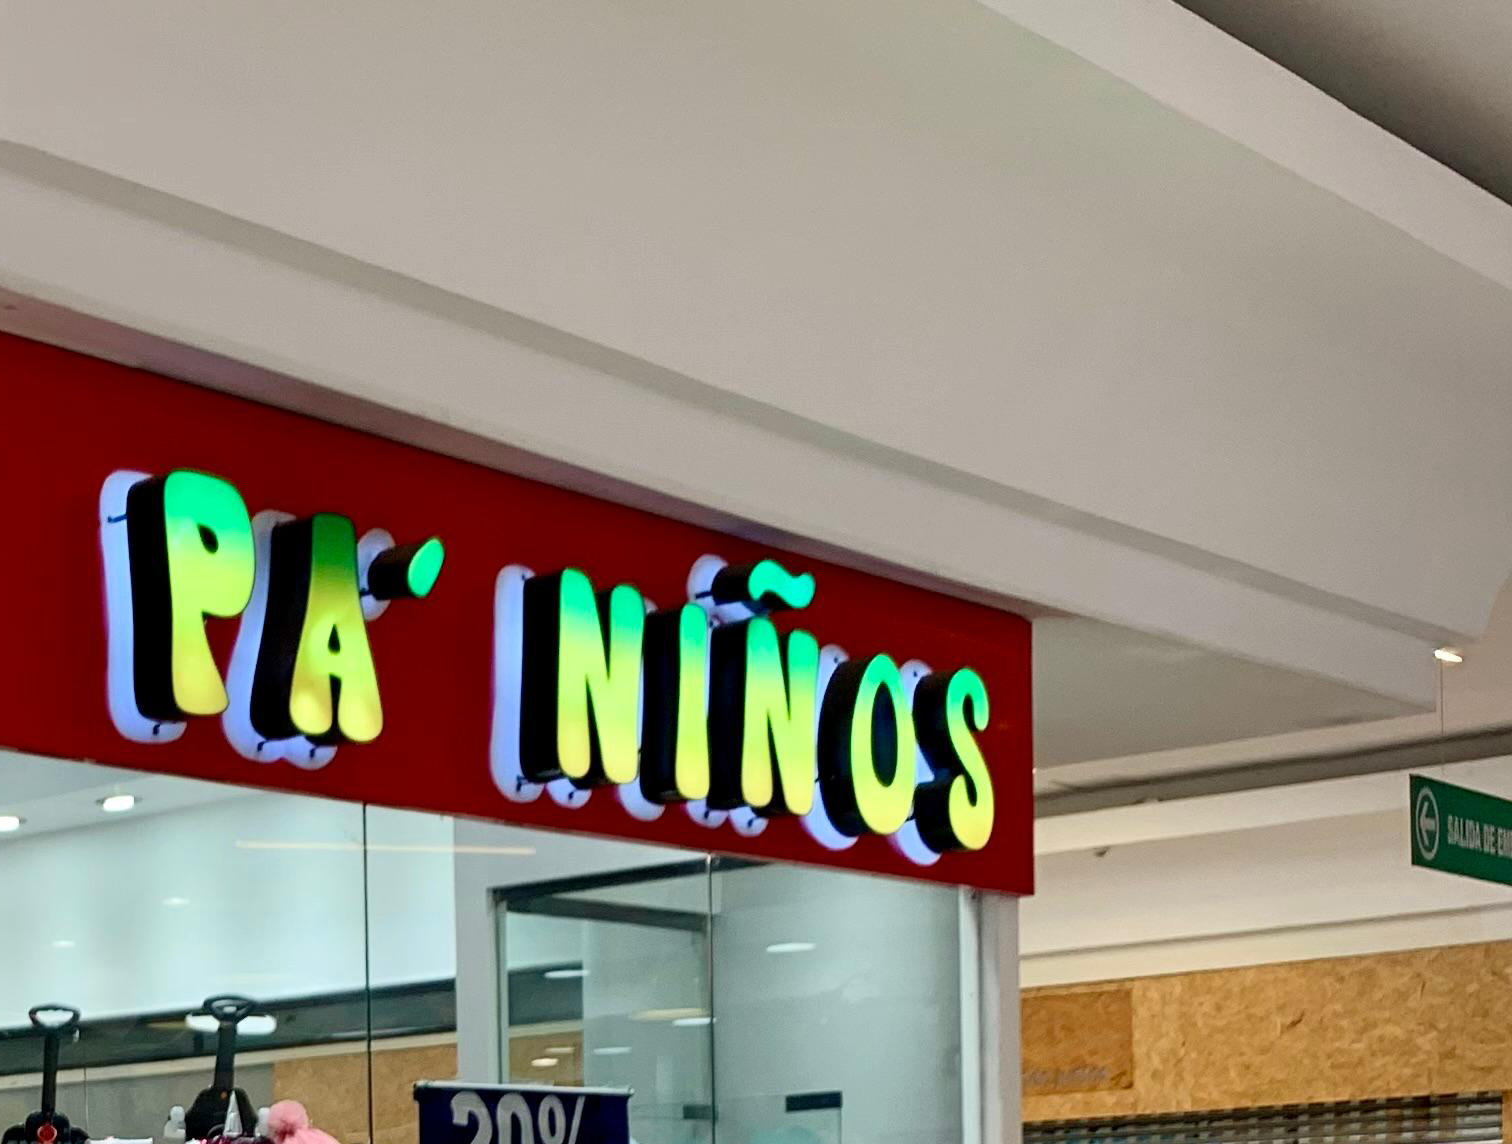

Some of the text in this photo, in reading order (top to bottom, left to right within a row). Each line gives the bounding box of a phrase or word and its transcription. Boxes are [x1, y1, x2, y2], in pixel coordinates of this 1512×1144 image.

[556, 558, 996, 851] NIÑOS
[1448, 814, 1482, 851] SALIDA
[1483, 823, 1496, 854] DE
